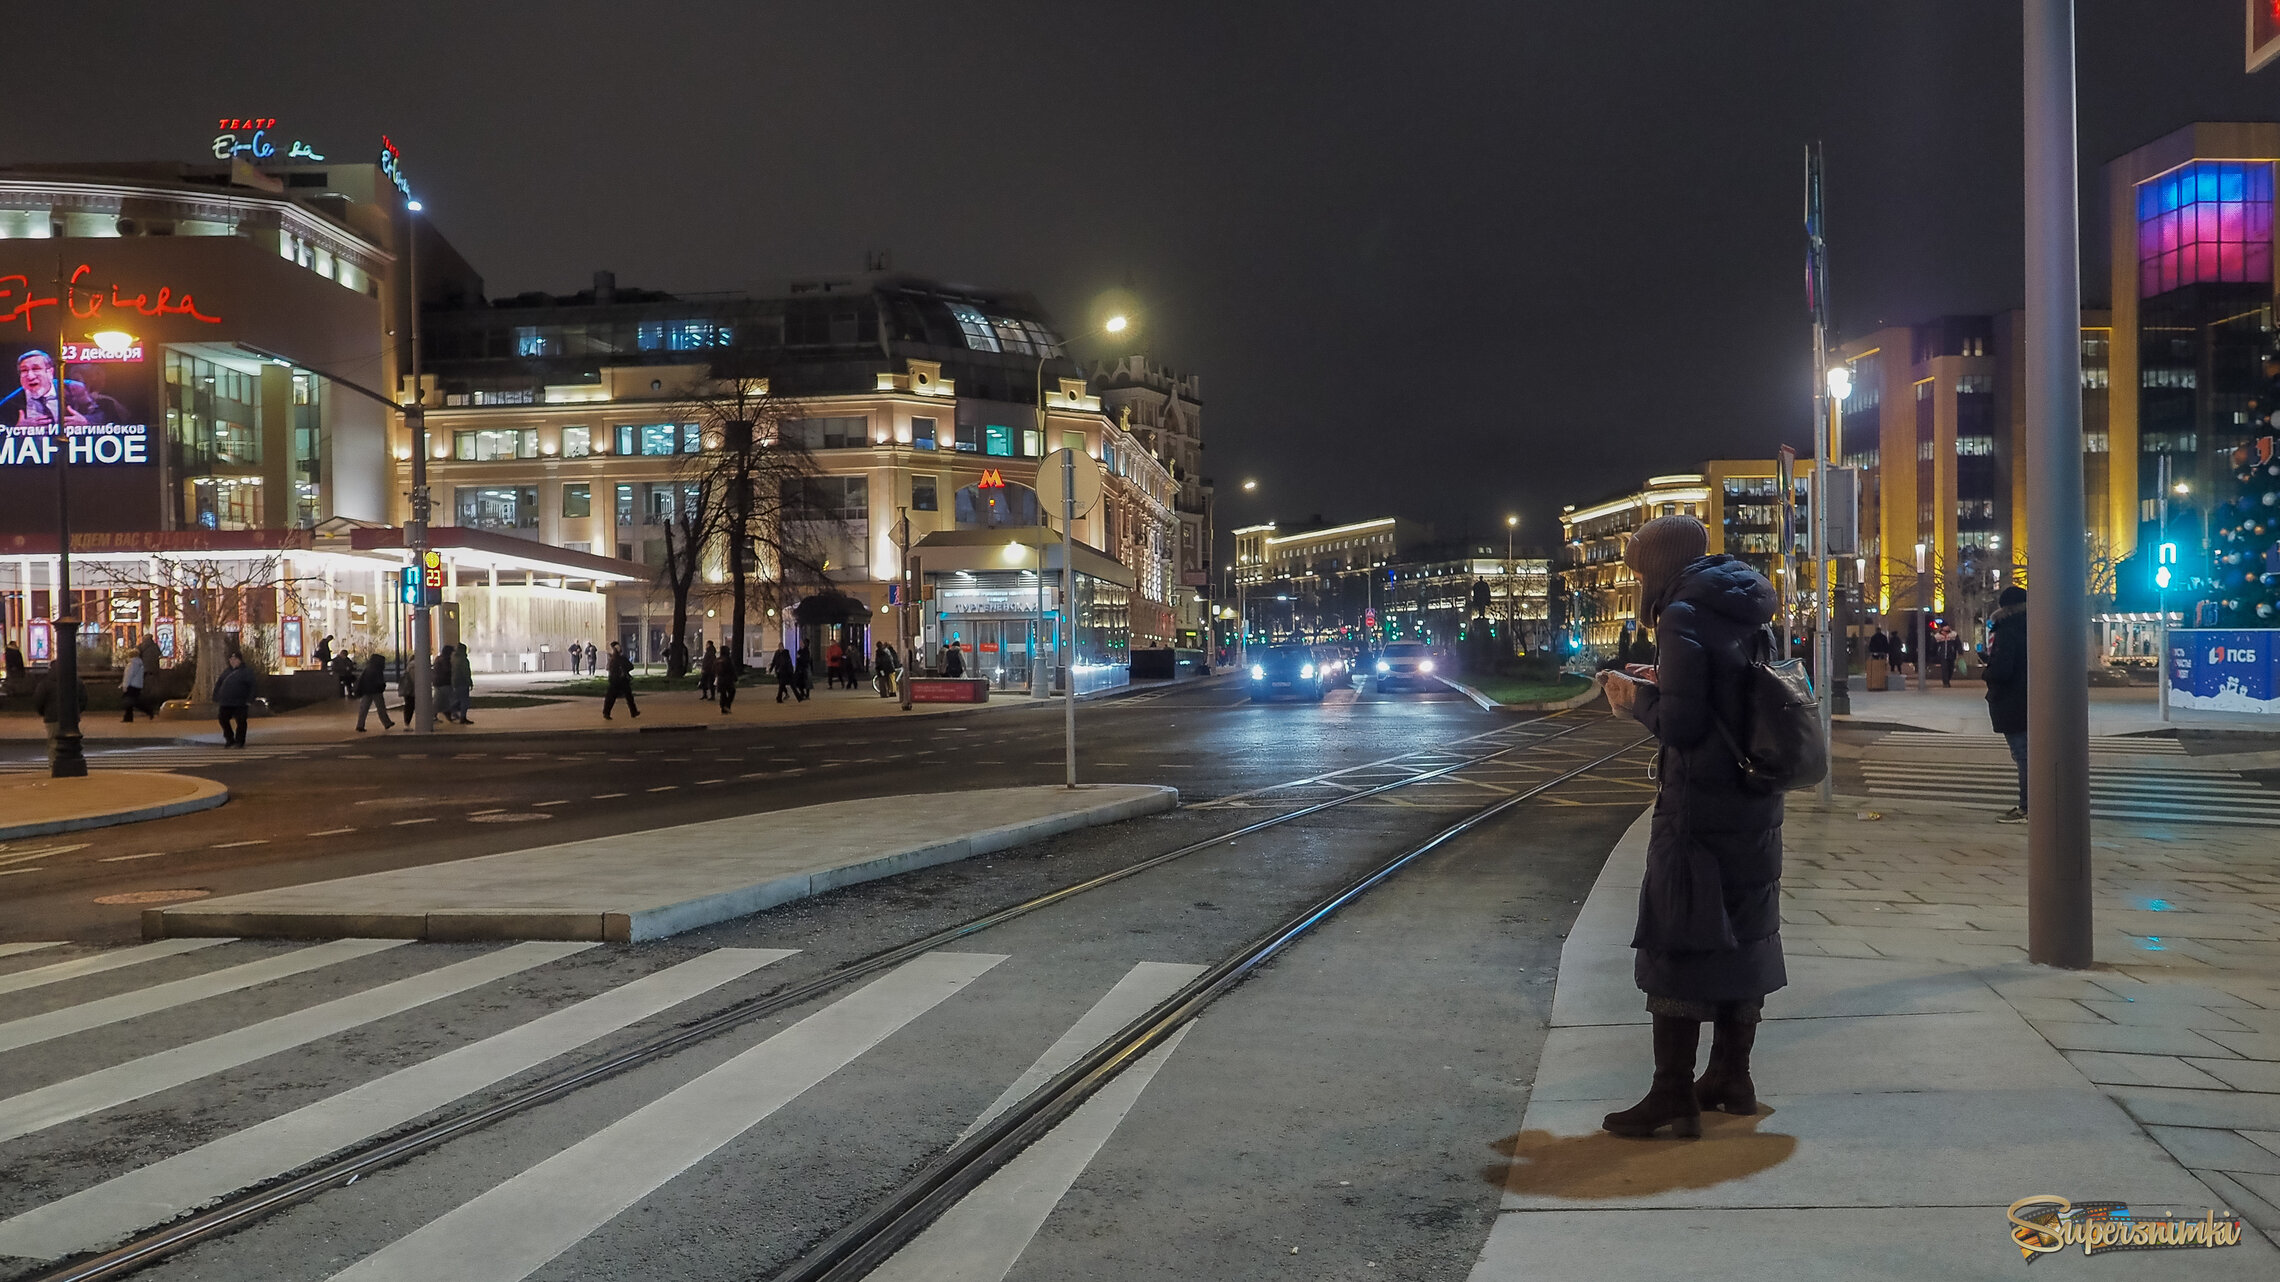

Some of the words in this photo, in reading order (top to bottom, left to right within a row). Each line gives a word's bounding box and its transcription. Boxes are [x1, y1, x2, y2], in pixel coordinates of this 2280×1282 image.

[219, 118, 276, 130] ТЕАТР
[114, 532, 140, 547] ВАС
[426, 569, 441, 587] 23
[2226, 648, 2257, 663] ПСБ
